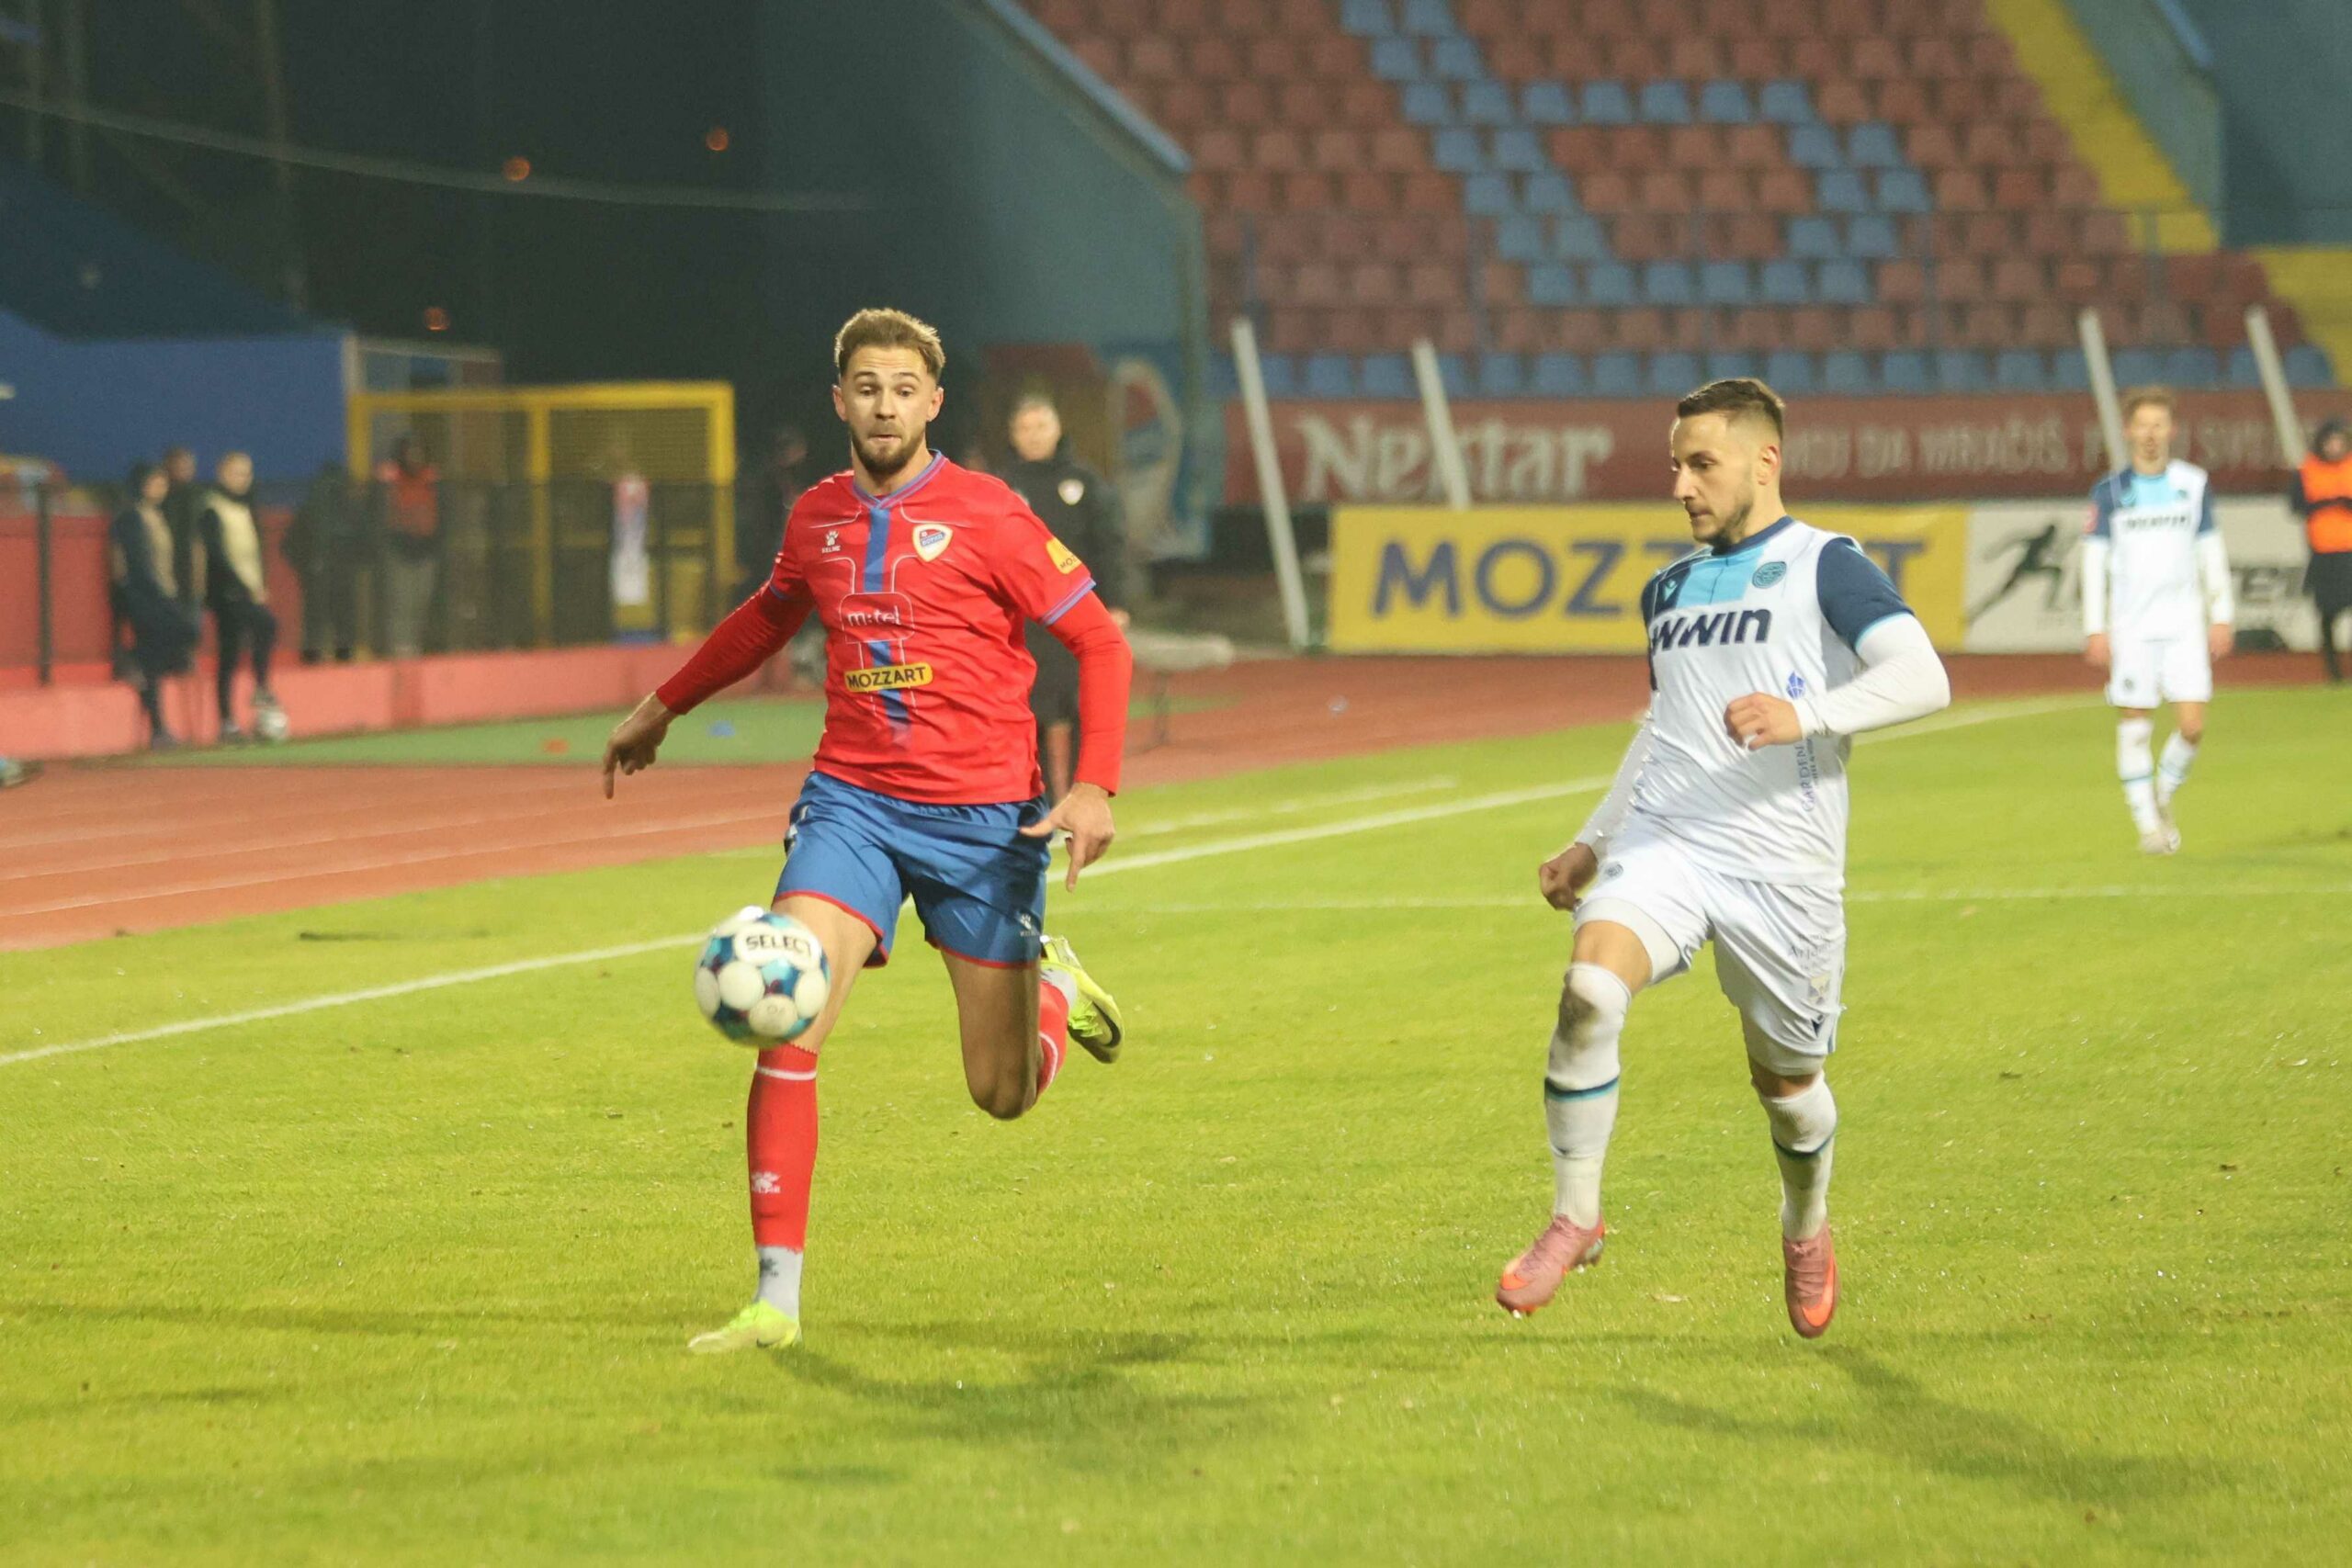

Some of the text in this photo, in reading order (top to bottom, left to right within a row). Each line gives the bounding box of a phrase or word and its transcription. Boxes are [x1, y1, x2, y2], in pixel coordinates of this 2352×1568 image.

[1373, 540, 1926, 619] MOZT
[846, 667, 926, 689] MOZZART
[745, 933, 812, 958] SELECT
